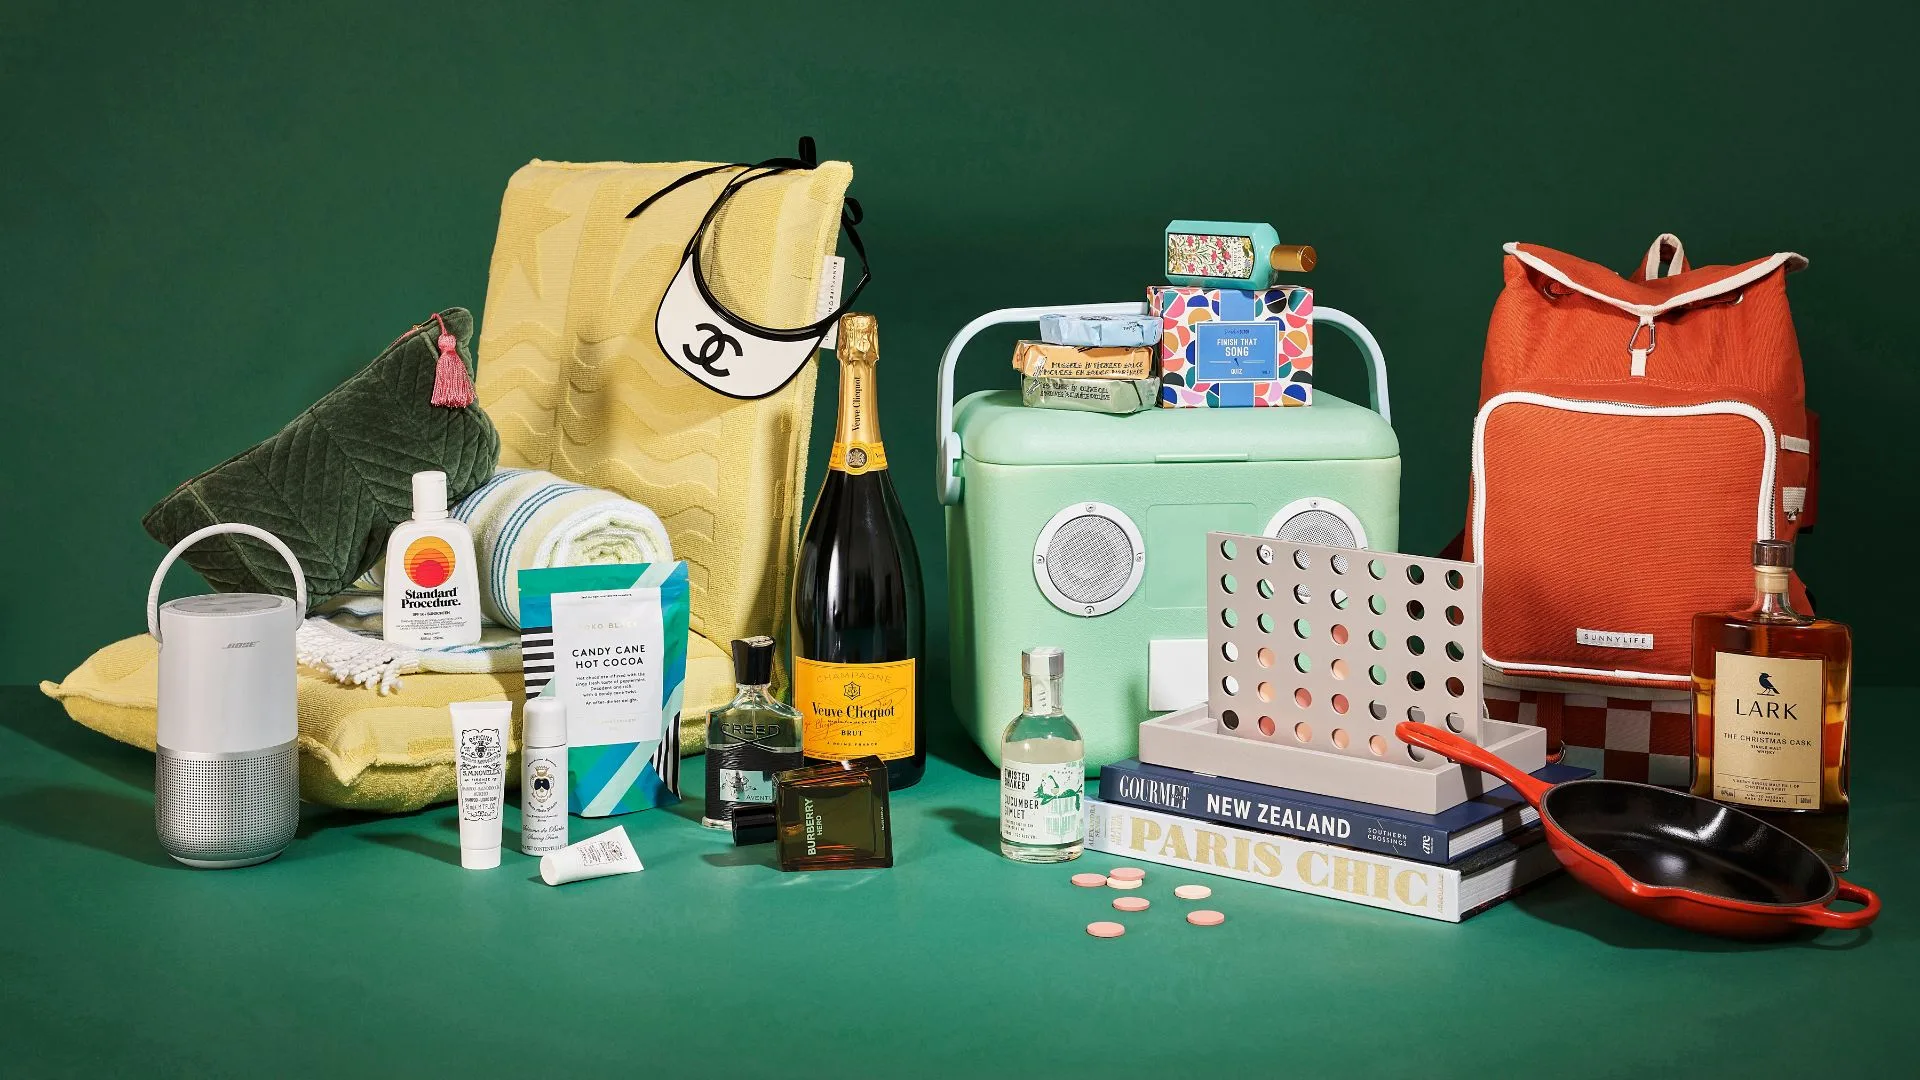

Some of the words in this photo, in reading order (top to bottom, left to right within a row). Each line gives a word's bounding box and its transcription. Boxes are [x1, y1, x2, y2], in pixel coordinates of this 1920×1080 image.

[1216, 338, 1238, 346] FINISH
[1240, 338, 1258, 346] THAT
[1225, 346, 1249, 357] SONG
[852, 377, 862, 409] Clicquot
[852, 409, 861, 432] Veuve
[405, 587, 458, 600] Standard
[401, 598, 461, 609] Procedure.
[1584, 634, 1646, 644] SUNNYLIFE
[572, 647, 611, 657] CANDY
[615, 645, 646, 654] CANE
[575, 660, 599, 669] HOT
[603, 657, 644, 667] COCOA
[816, 671, 892, 684] CHAMPAGNE
[812, 701, 843, 718] Veuve
[846, 704, 895, 721] Clicquot
[1735, 698, 1798, 721] LARK
[721, 722, 780, 736] CREED
[841, 729, 863, 737] BRUT
[1723, 732, 1737, 740] THE
[1740, 734, 1787, 745] CHRISTMAS
[1789, 739, 1812, 747] CASK
[1119, 775, 1190, 810] GOURMET
[1206, 793, 1252, 820] NEW
[1257, 803, 1351, 839] ZEALAND
[804, 798, 816, 856] BURBERRY
[815, 815, 823, 836] HERO
[1367, 827, 1407, 840] SOUTHERN
[1367, 833, 1407, 847] CROSSINGS
[1129, 816, 1283, 878] PARIS
[1296, 850, 1428, 907] CHIC
